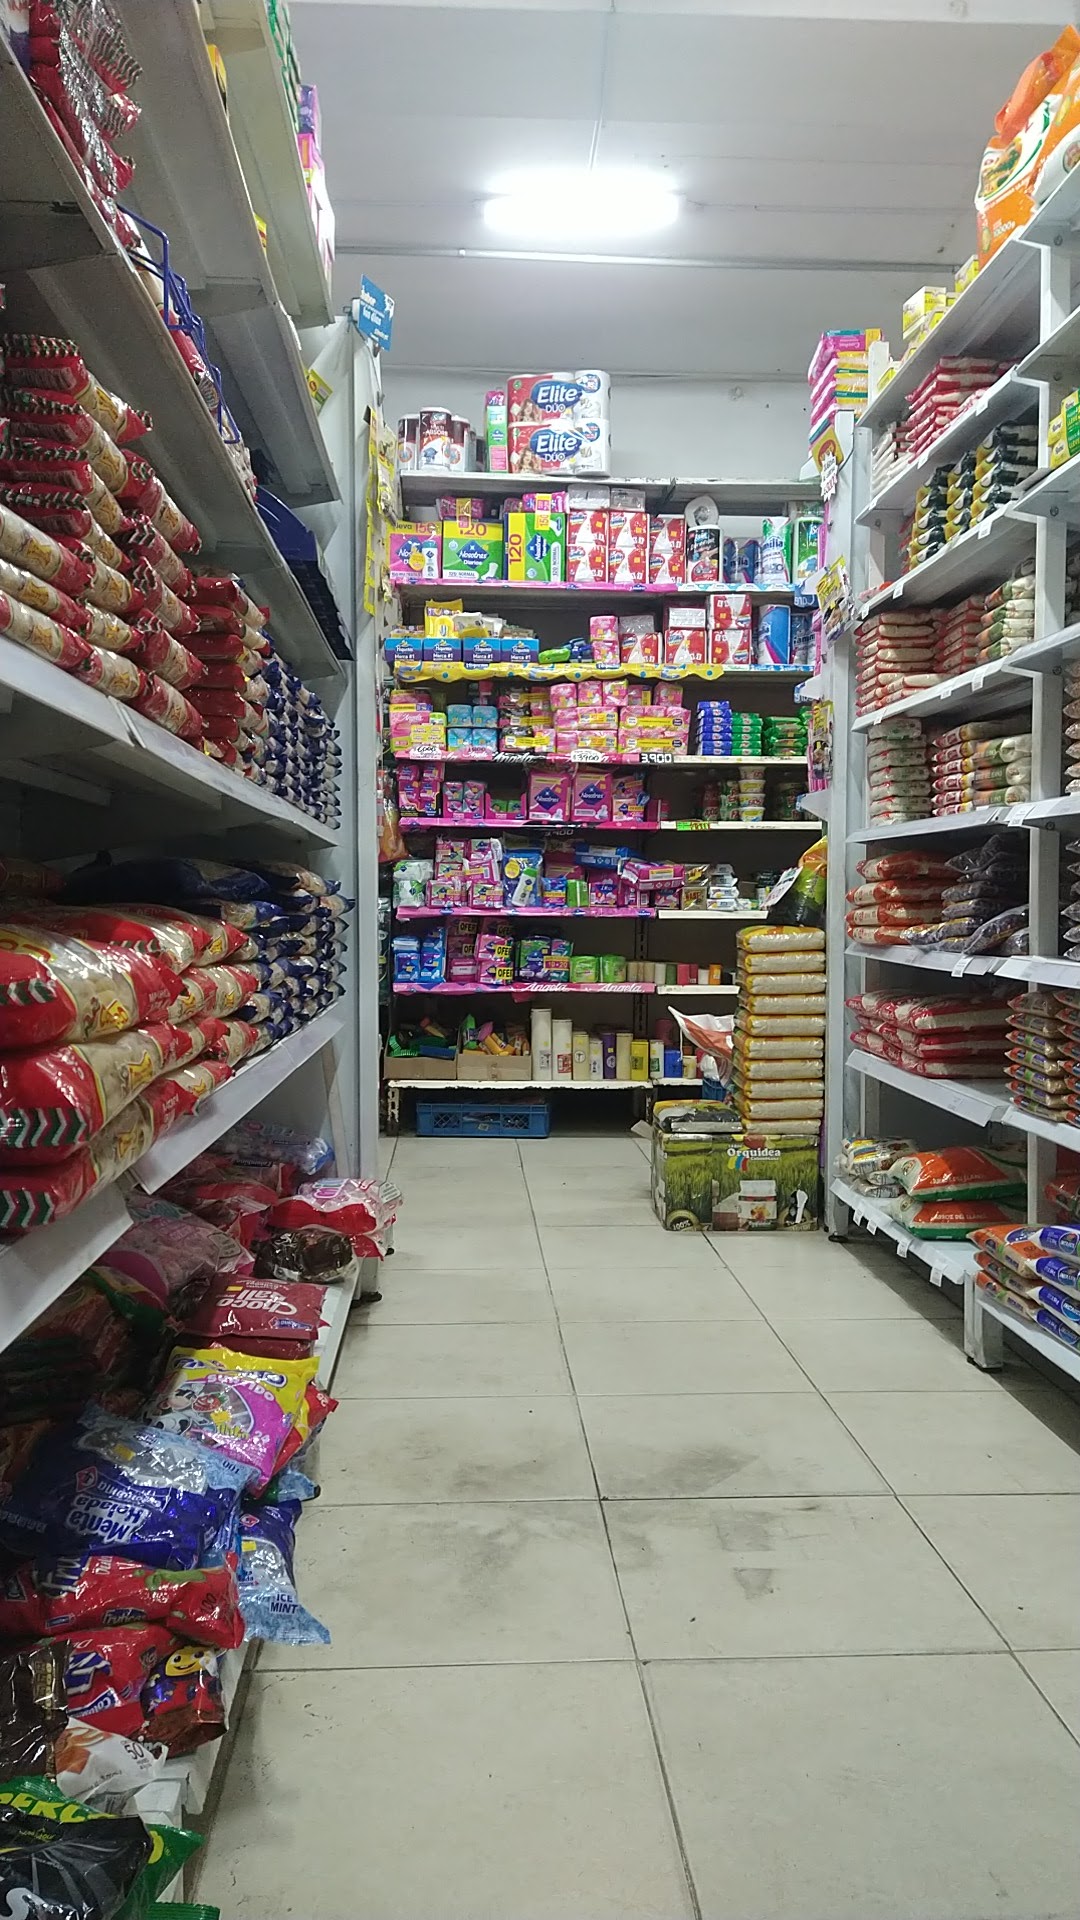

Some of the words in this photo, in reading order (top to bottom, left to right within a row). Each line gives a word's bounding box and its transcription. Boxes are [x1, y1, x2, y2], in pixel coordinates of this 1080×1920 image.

[537, 385, 578, 404] Elite
[545, 403, 566, 413] DÚO
[536, 433, 578, 453] Elite
[544, 452, 566, 463] DÚO
[459, 550, 489, 559] Nosotras
[509, 534, 522, 565] 120
[641, 754, 672, 764] 3.900
[525, 983, 569, 992] Angela
[727, 1148, 781, 1158] Orquidea
[672, 1219, 692, 1231] 100%
[216, 1298, 298, 1316] Choco
[222, 1460, 240, 1474] 100
[75, 1495, 144, 1524] Helada
[68, 1511, 131, 1544] Menta
[276, 1593, 293, 1603] ICE
[270, 1602, 298, 1614] MINT
[124, 1740, 145, 1760] 50
